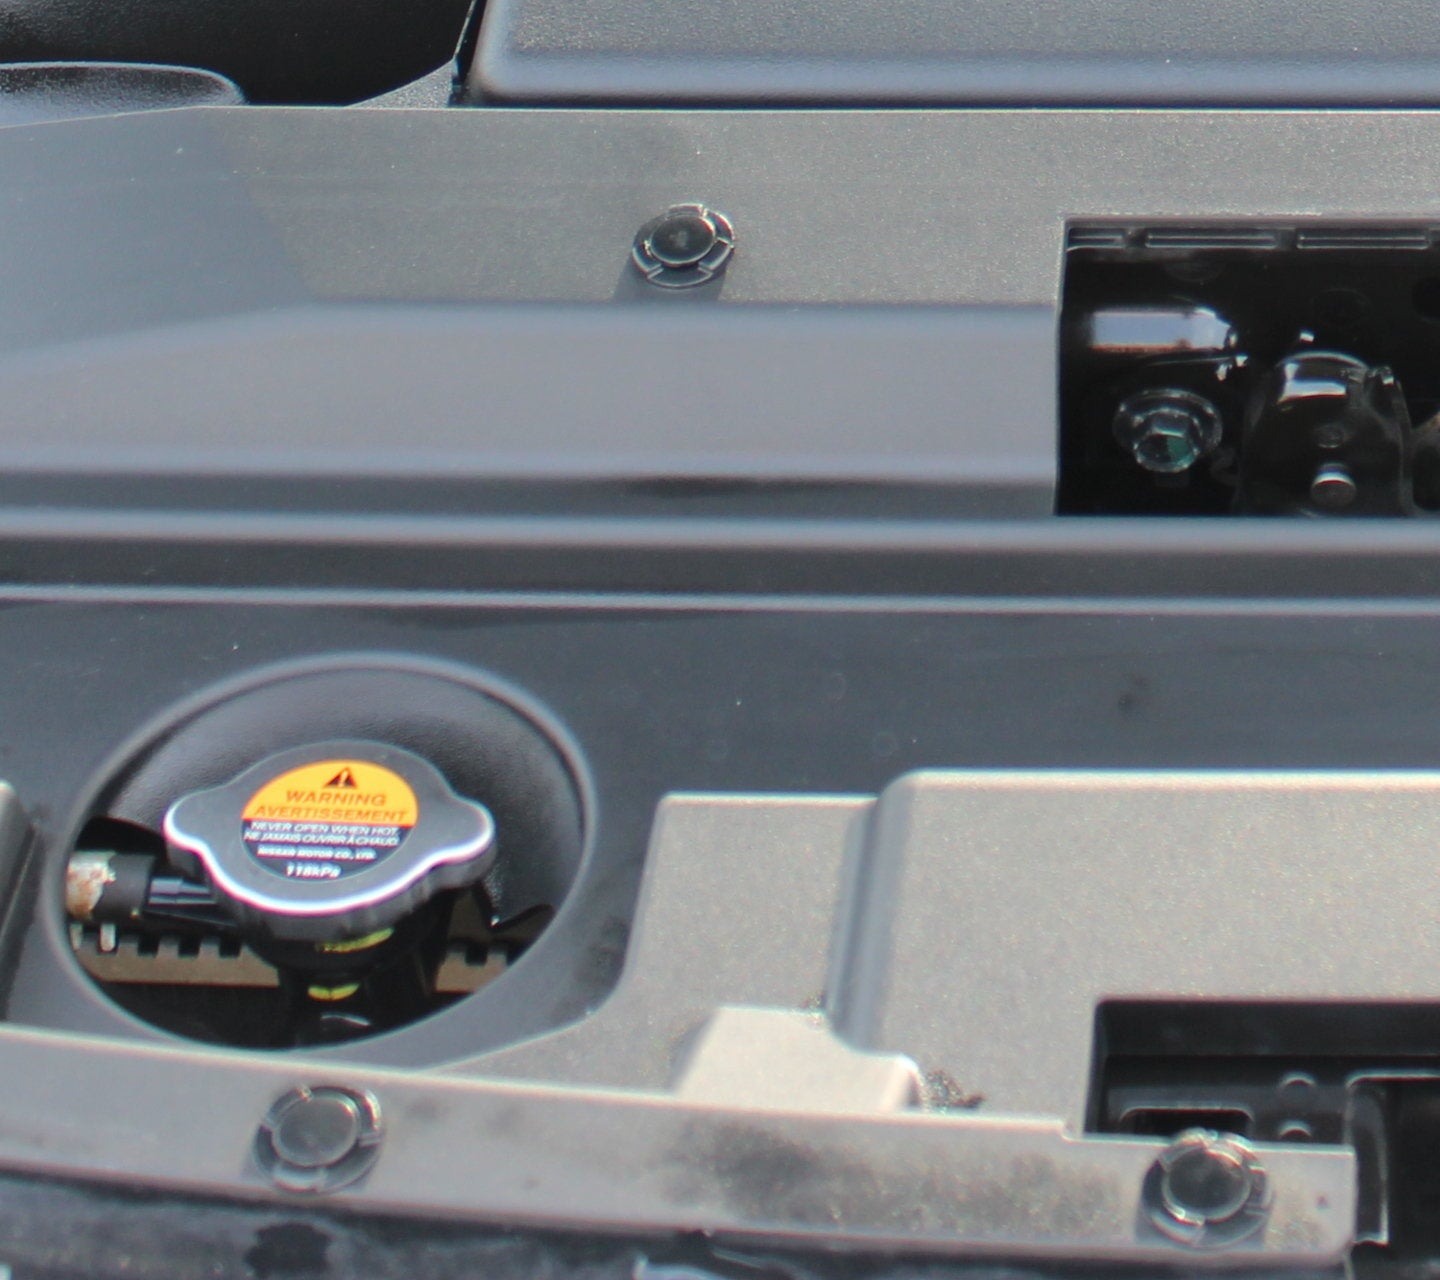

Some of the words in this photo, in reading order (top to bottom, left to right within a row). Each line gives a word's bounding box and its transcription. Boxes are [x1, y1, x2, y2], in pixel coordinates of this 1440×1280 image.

[286, 790, 388, 807] WARNING
[254, 805, 407, 823] AVERTISSEMENT
[250, 821, 291, 832] NEVER
[294, 822, 328, 833] OPEN
[331, 824, 370, 835] WHEN
[244, 830, 259, 840] NE
[261, 831, 301, 843] JAMAIS
[302, 833, 346, 845] OUVRIR
